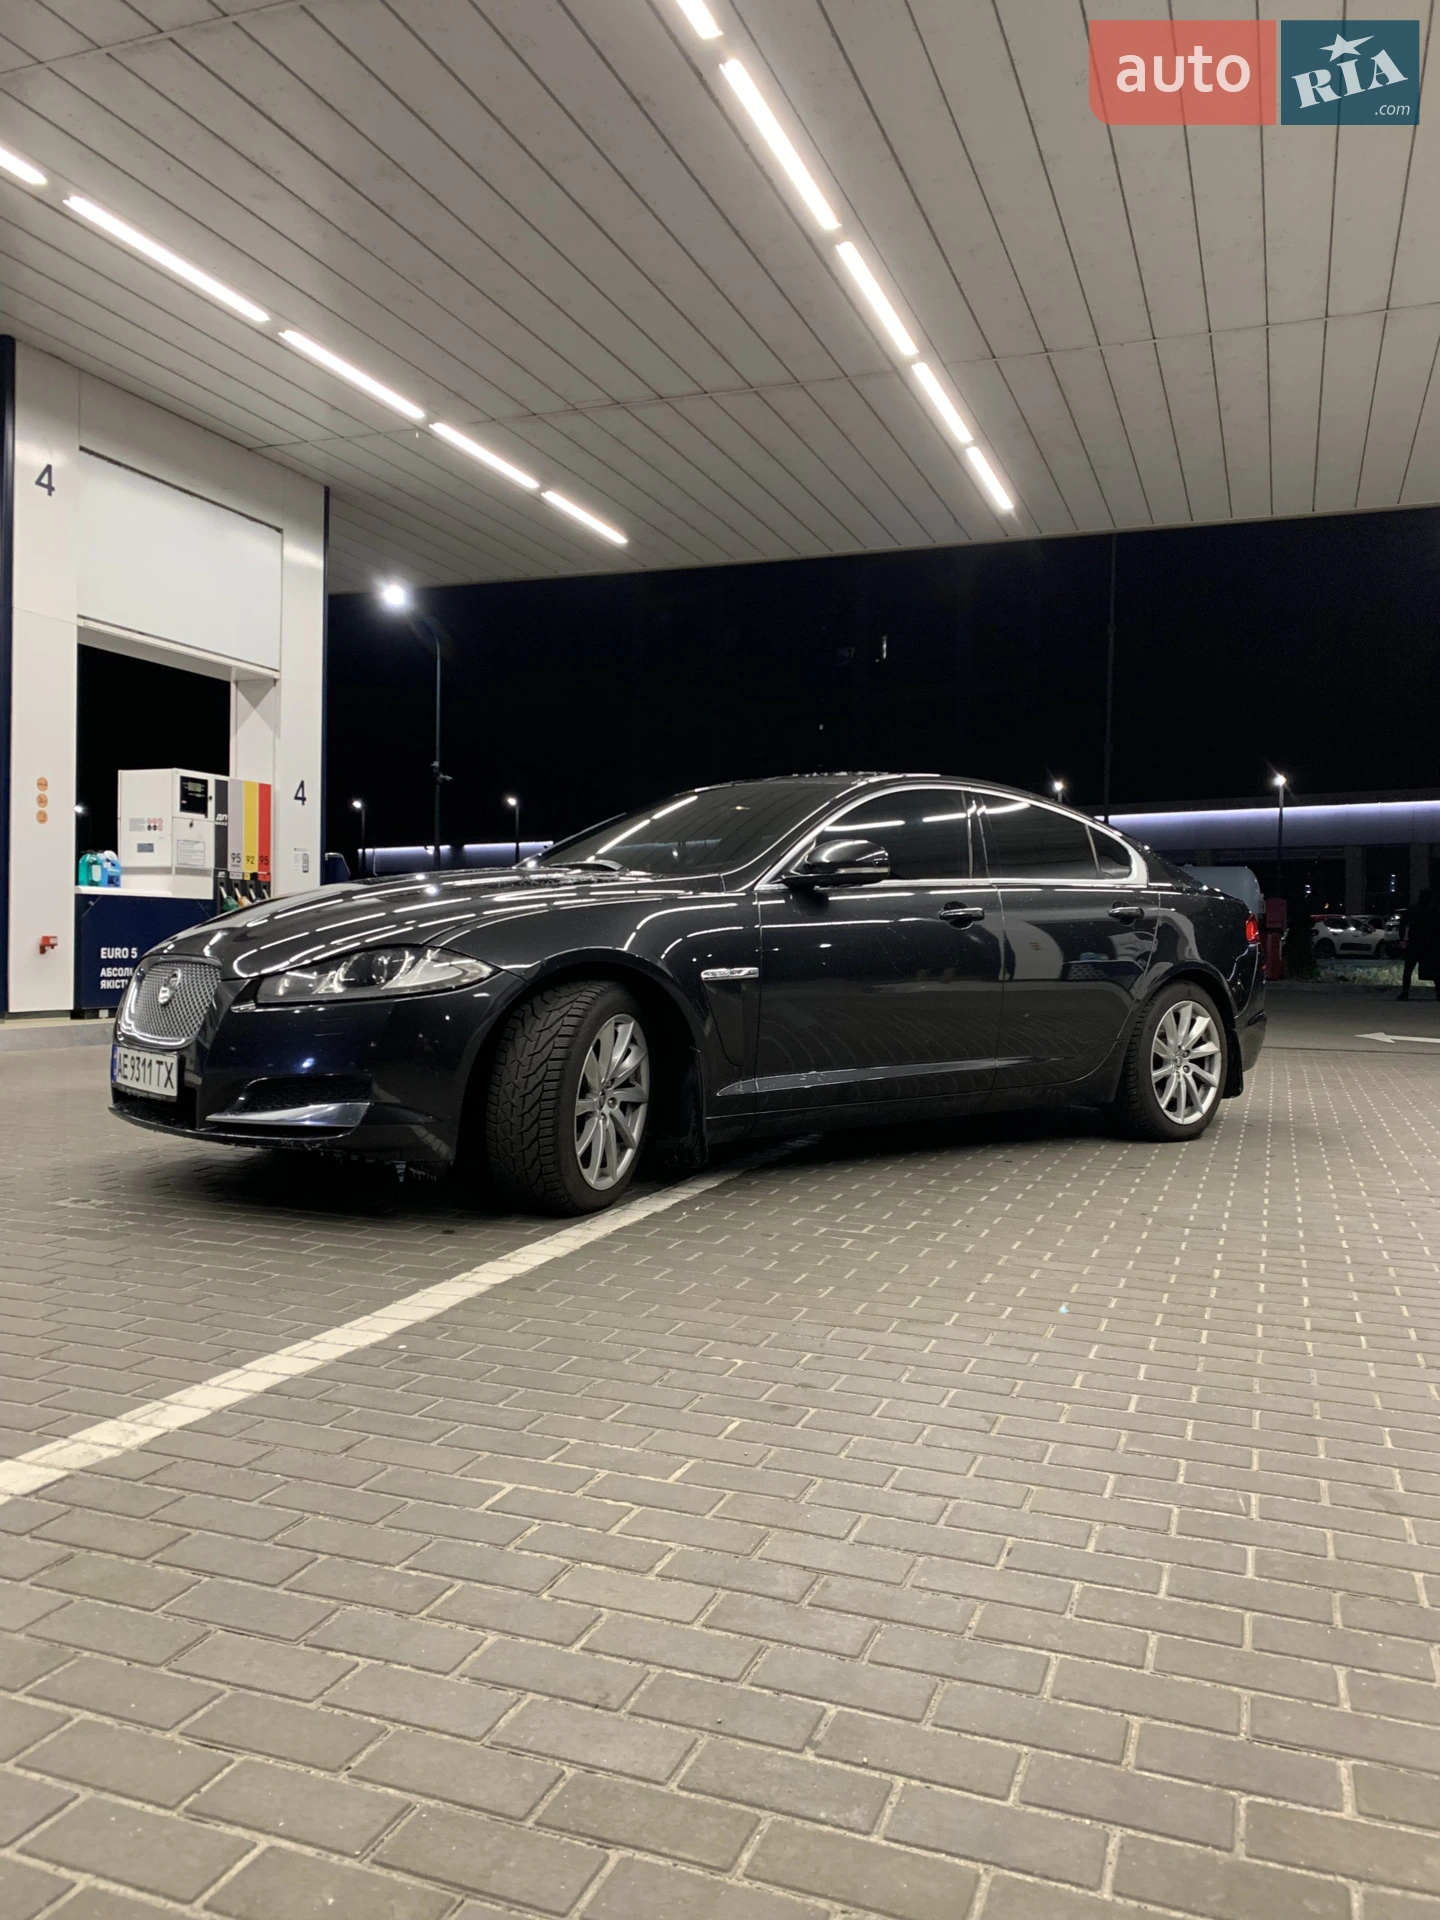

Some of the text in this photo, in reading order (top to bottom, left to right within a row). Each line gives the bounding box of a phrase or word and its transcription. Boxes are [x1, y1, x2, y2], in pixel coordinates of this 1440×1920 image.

[35, 463, 55, 497] 4
[294, 780, 307, 806] 4
[231, 852, 241, 863] 95
[246, 855, 255, 865] 92
[259, 854, 269, 866] 95
[100, 947, 138, 959] EURO 5
